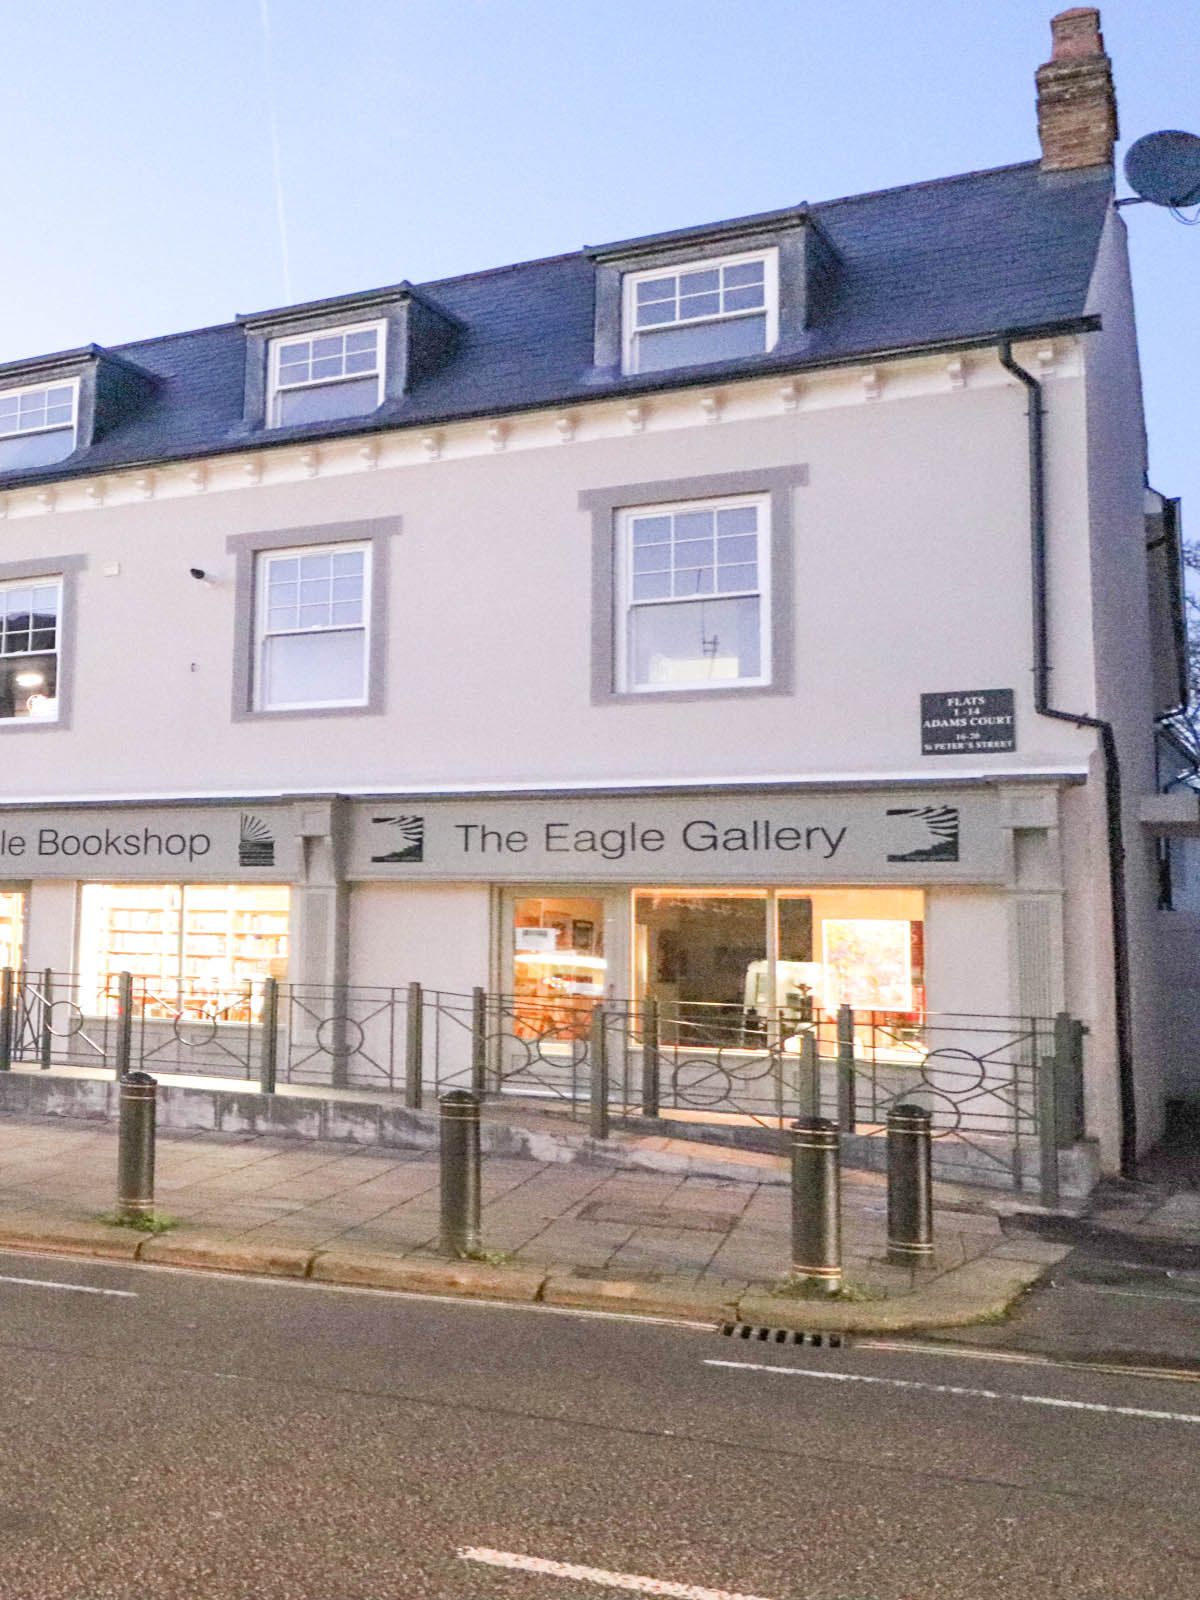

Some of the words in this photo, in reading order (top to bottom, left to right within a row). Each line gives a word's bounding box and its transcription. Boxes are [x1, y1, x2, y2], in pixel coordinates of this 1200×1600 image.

[947, 696, 985, 707] FLATS
[923, 718, 967, 728] ADAMS
[969, 716, 1012, 726] COURT
[976, 740, 1013, 749] STREET
[37, 826, 211, 864] Bookshop
[453, 824, 529, 854] The
[544, 821, 665, 861] Eagle
[681, 818, 848, 860] Gallery
